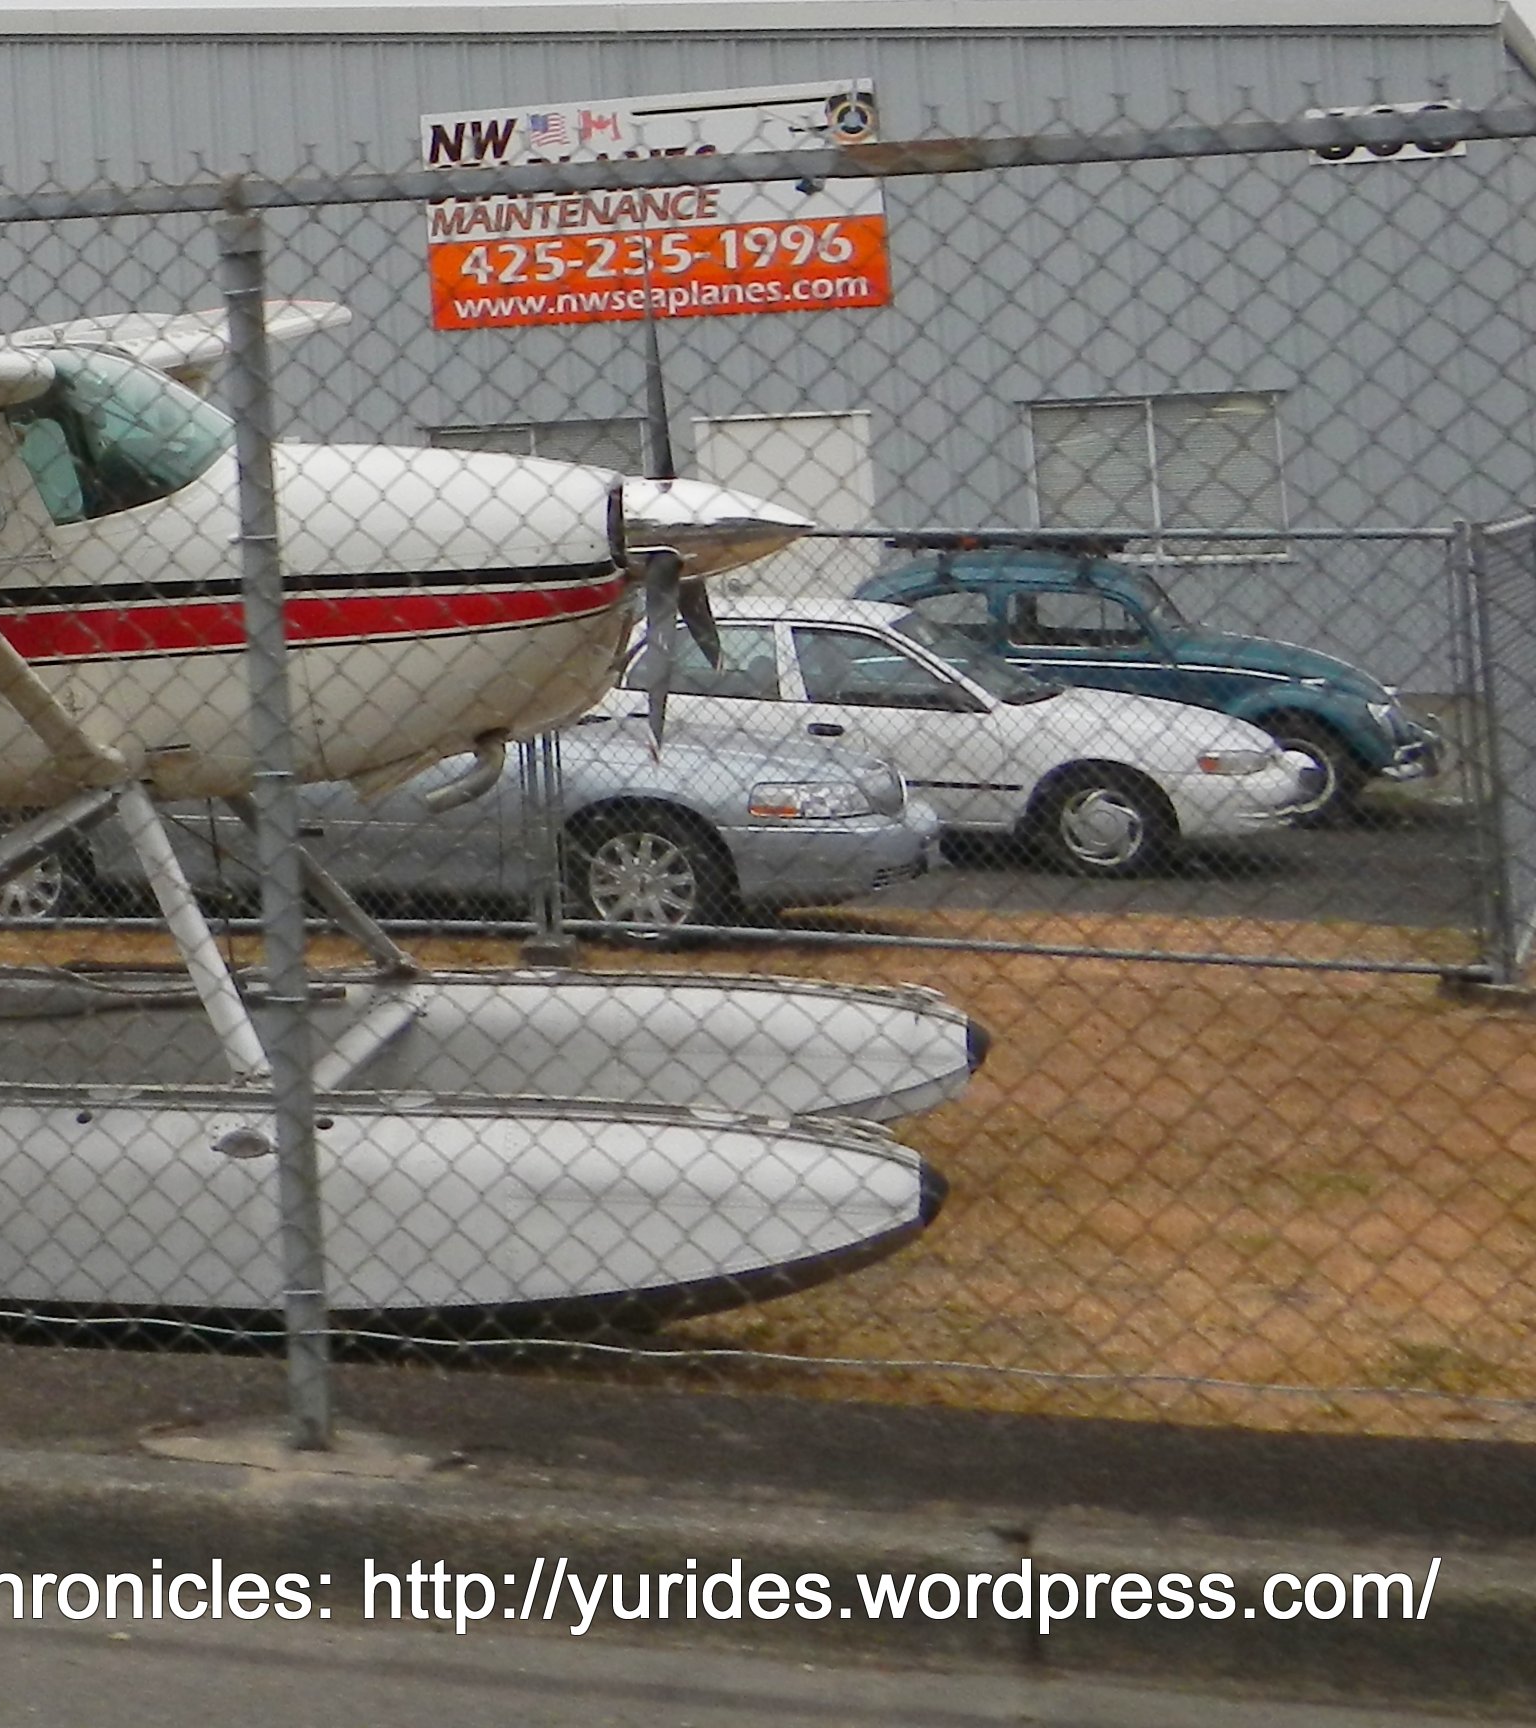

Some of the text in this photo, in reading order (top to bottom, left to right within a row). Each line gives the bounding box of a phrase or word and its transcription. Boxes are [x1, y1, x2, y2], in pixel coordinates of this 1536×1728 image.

[429, 118, 517, 164] NW
[430, 187, 721, 237] MAINTENANCE
[460, 222, 854, 286] 425-235-1996
[454, 273, 870, 321] www.nwseaplanes.com
